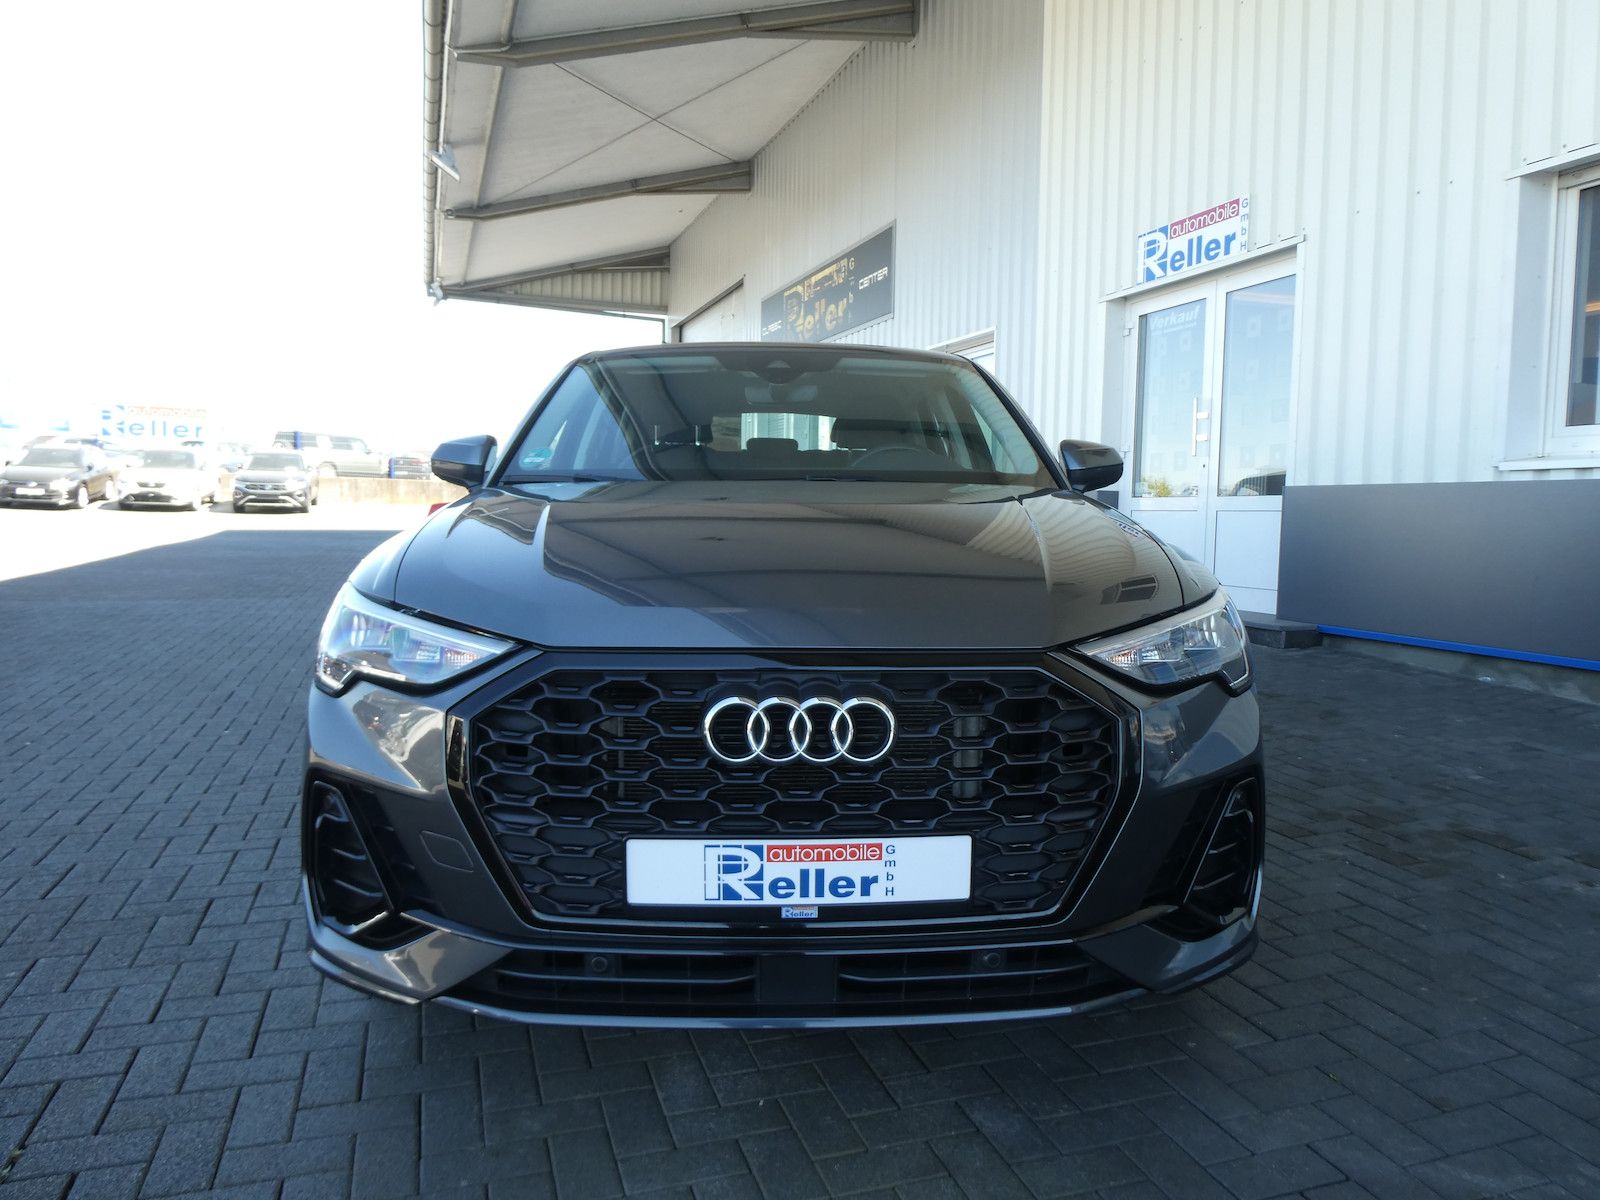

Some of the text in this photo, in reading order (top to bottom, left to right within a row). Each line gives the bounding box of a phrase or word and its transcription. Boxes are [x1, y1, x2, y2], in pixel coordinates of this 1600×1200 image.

[1170, 202, 1239, 238] automobile
[1137, 225, 1236, 285] Reller
[1150, 305, 1200, 330] Verkauf
[704, 845, 879, 901] Reller
[769, 845, 880, 861] automobile
[884, 844, 896, 897] GmbH
